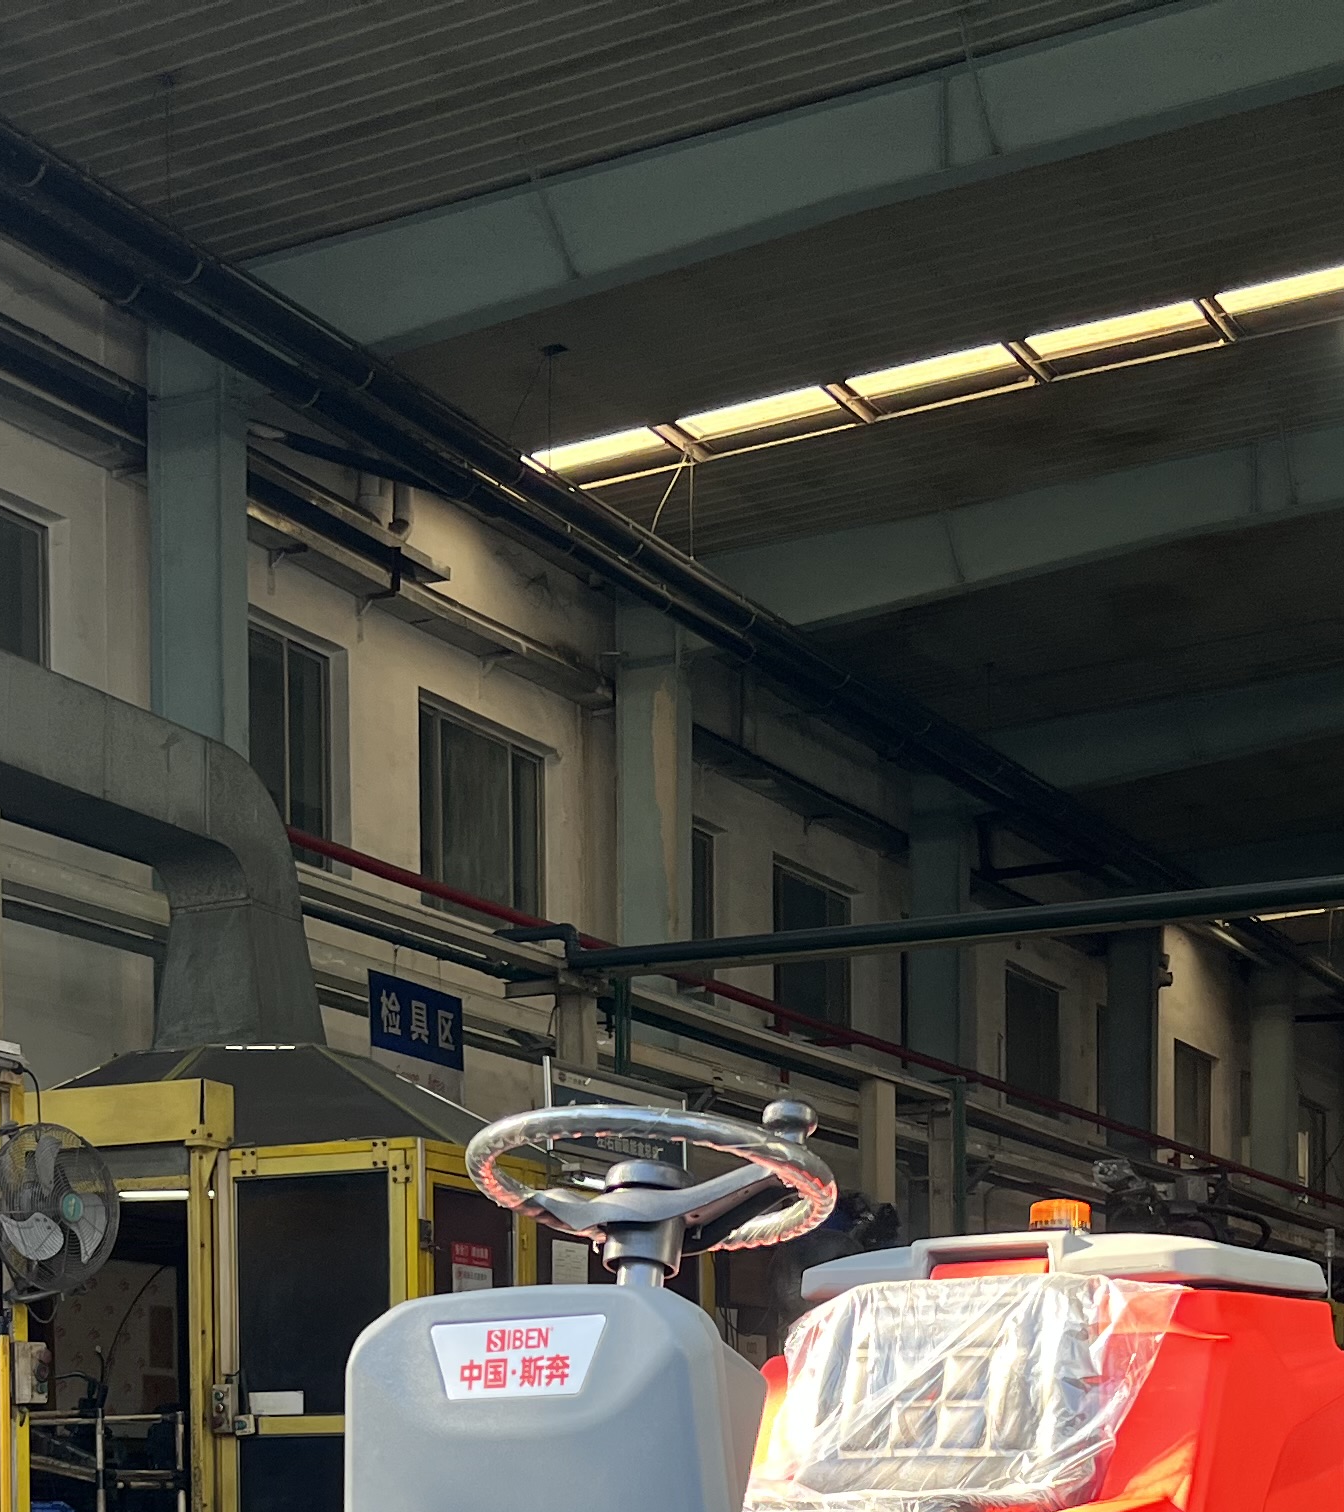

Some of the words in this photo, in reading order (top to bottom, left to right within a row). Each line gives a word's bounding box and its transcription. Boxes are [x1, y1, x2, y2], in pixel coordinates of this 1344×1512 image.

[381, 988, 455, 1051] 检具区
[486, 1327, 549, 1353] SIBEN
